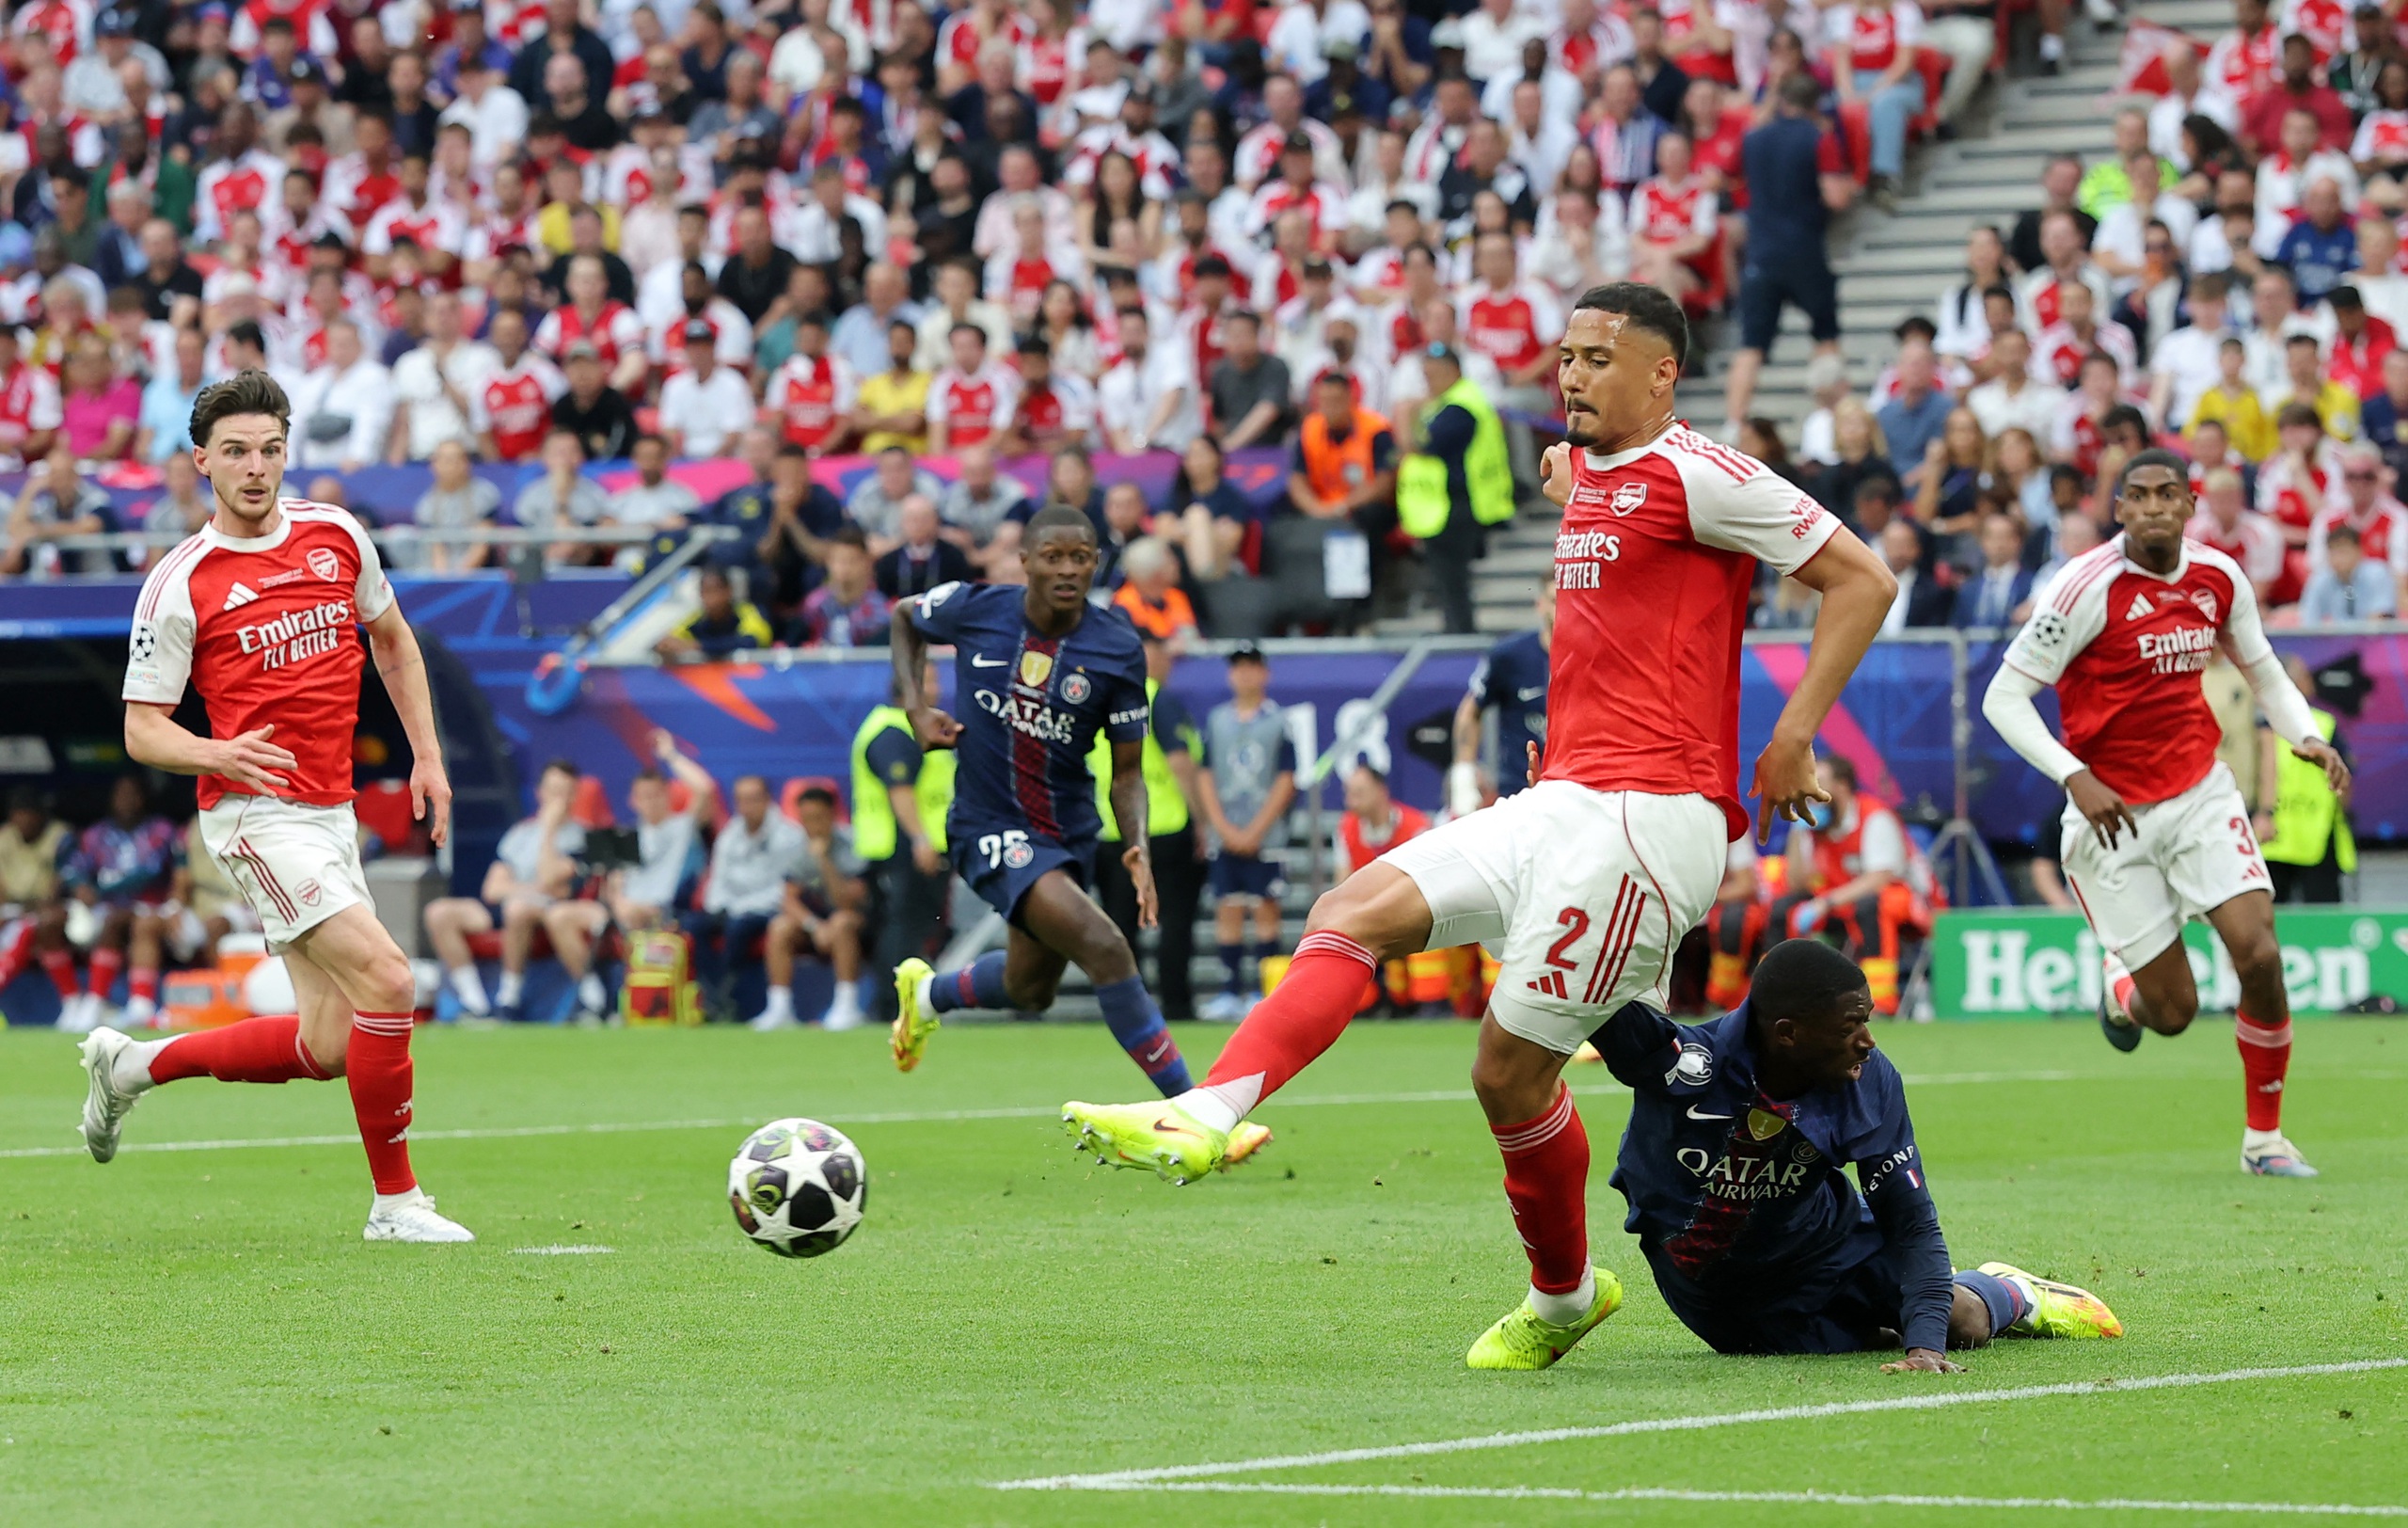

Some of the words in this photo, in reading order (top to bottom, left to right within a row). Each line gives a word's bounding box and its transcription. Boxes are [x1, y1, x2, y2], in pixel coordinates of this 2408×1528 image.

[236, 599, 350, 655] Emirates
[262, 643, 287, 671] FLY
[290, 627, 340, 662] BETTER
[974, 689, 1076, 733] QATAR
[2228, 816, 2255, 855] 3
[1545, 905, 1591, 972] 2
[1676, 1147, 1807, 1186] QATAR
[1700, 1181, 1797, 1201] AIRWAYS
